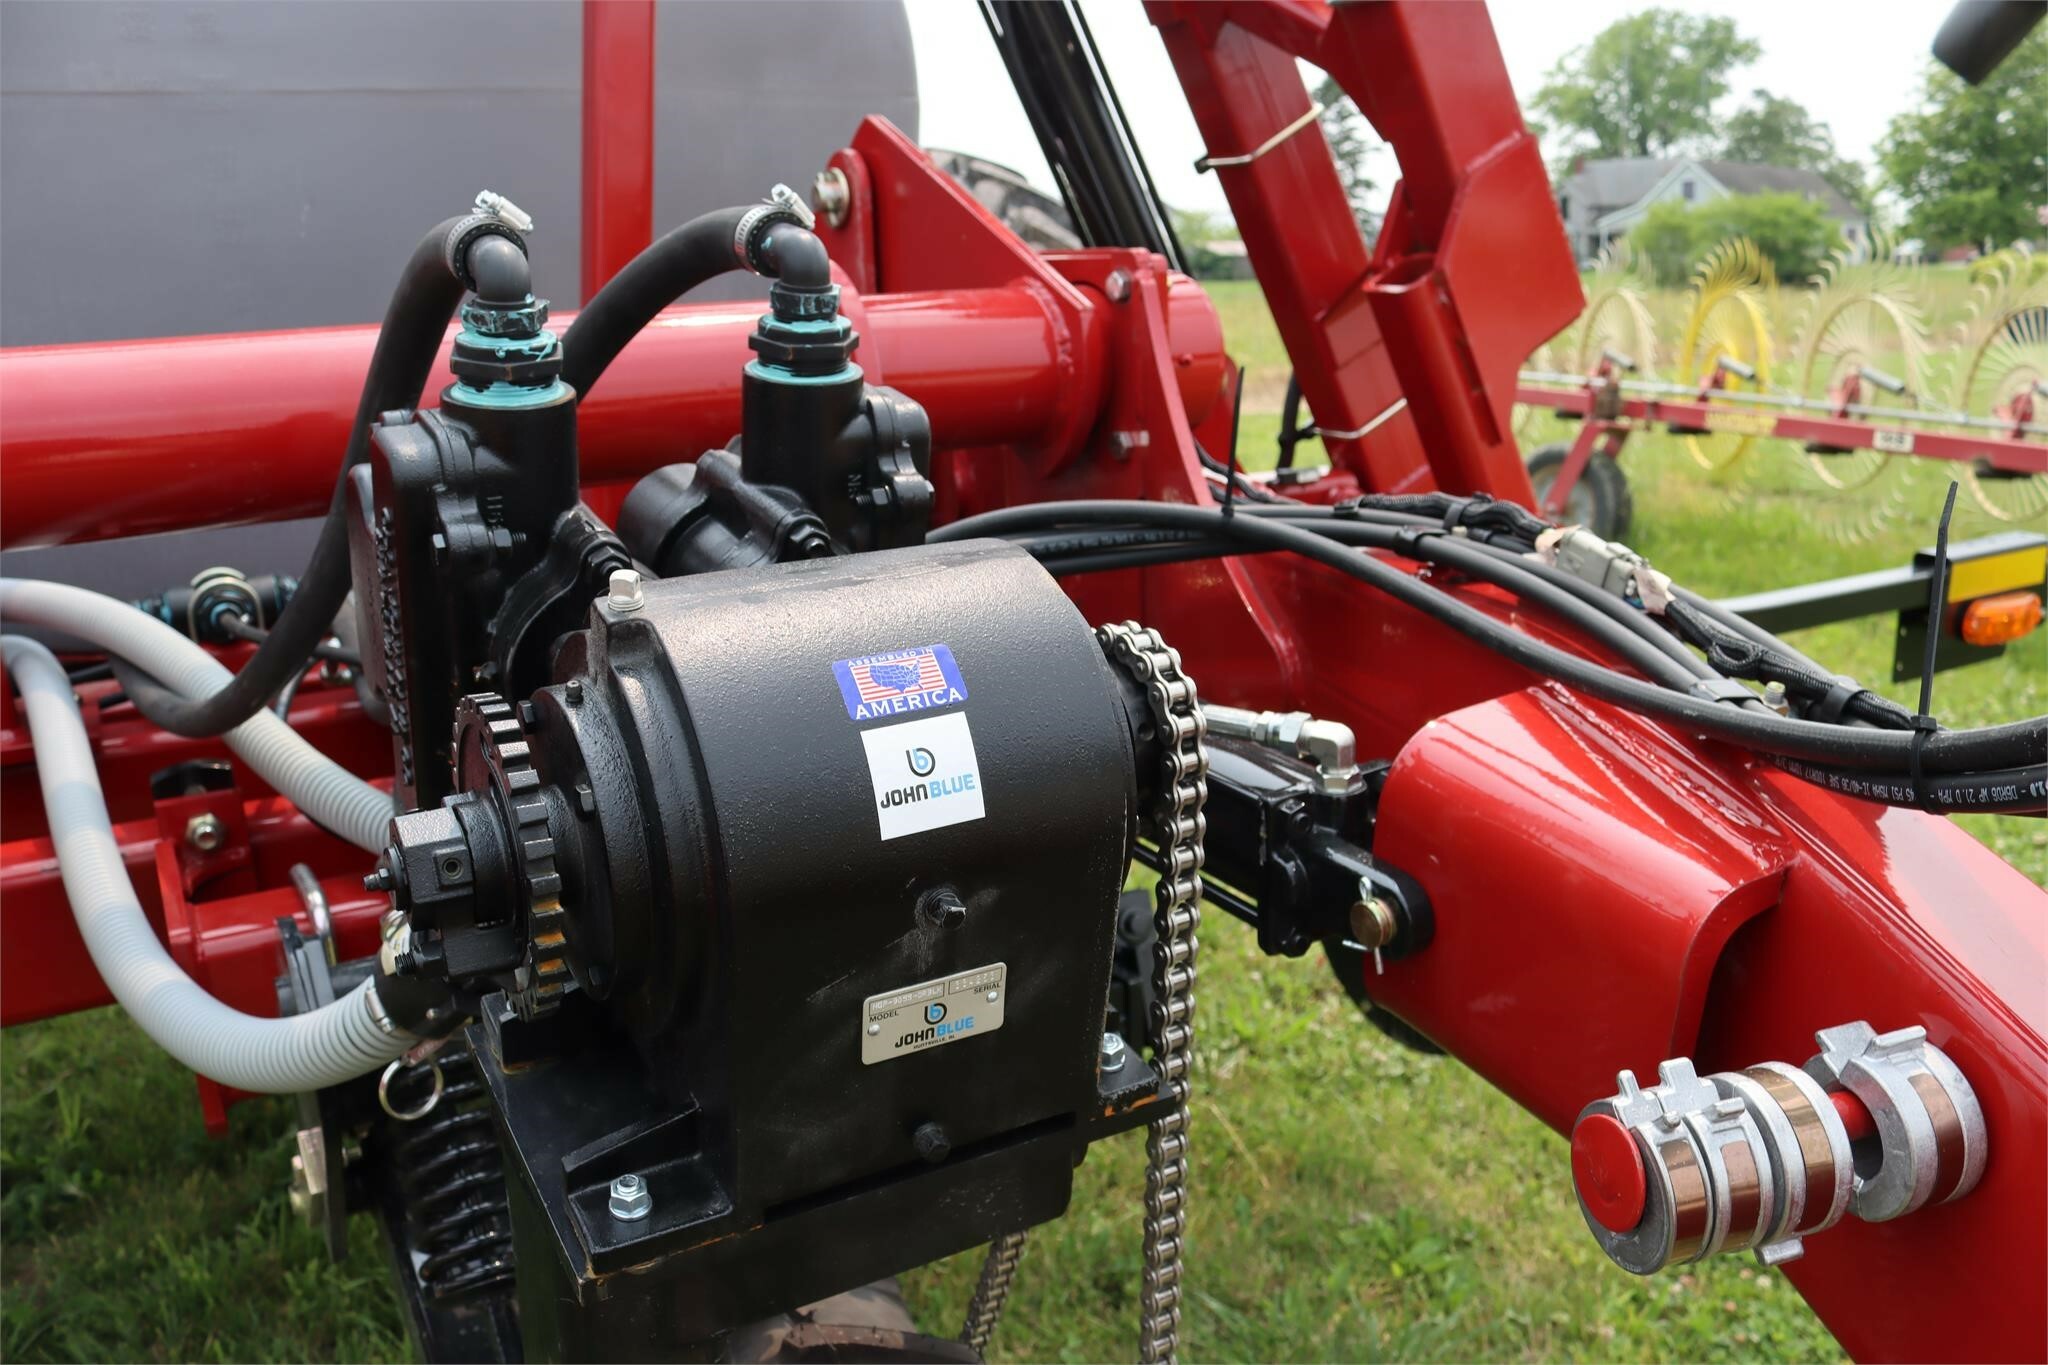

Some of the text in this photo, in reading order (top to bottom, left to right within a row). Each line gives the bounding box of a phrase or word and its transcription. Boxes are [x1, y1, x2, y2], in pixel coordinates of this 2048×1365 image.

[848, 648, 933, 667] ASSEMBLED IN
[855, 687, 963, 720] AMERICA
[1872, 783, 1888, 799] MSHA
[1891, 786, 1904, 801] PSI
[1938, 789, 1954, 803] MPA
[1978, 787, 1989, 803] WP
[973, 982, 1001, 994] SERIAL
[869, 1010, 899, 1023] MODEL
